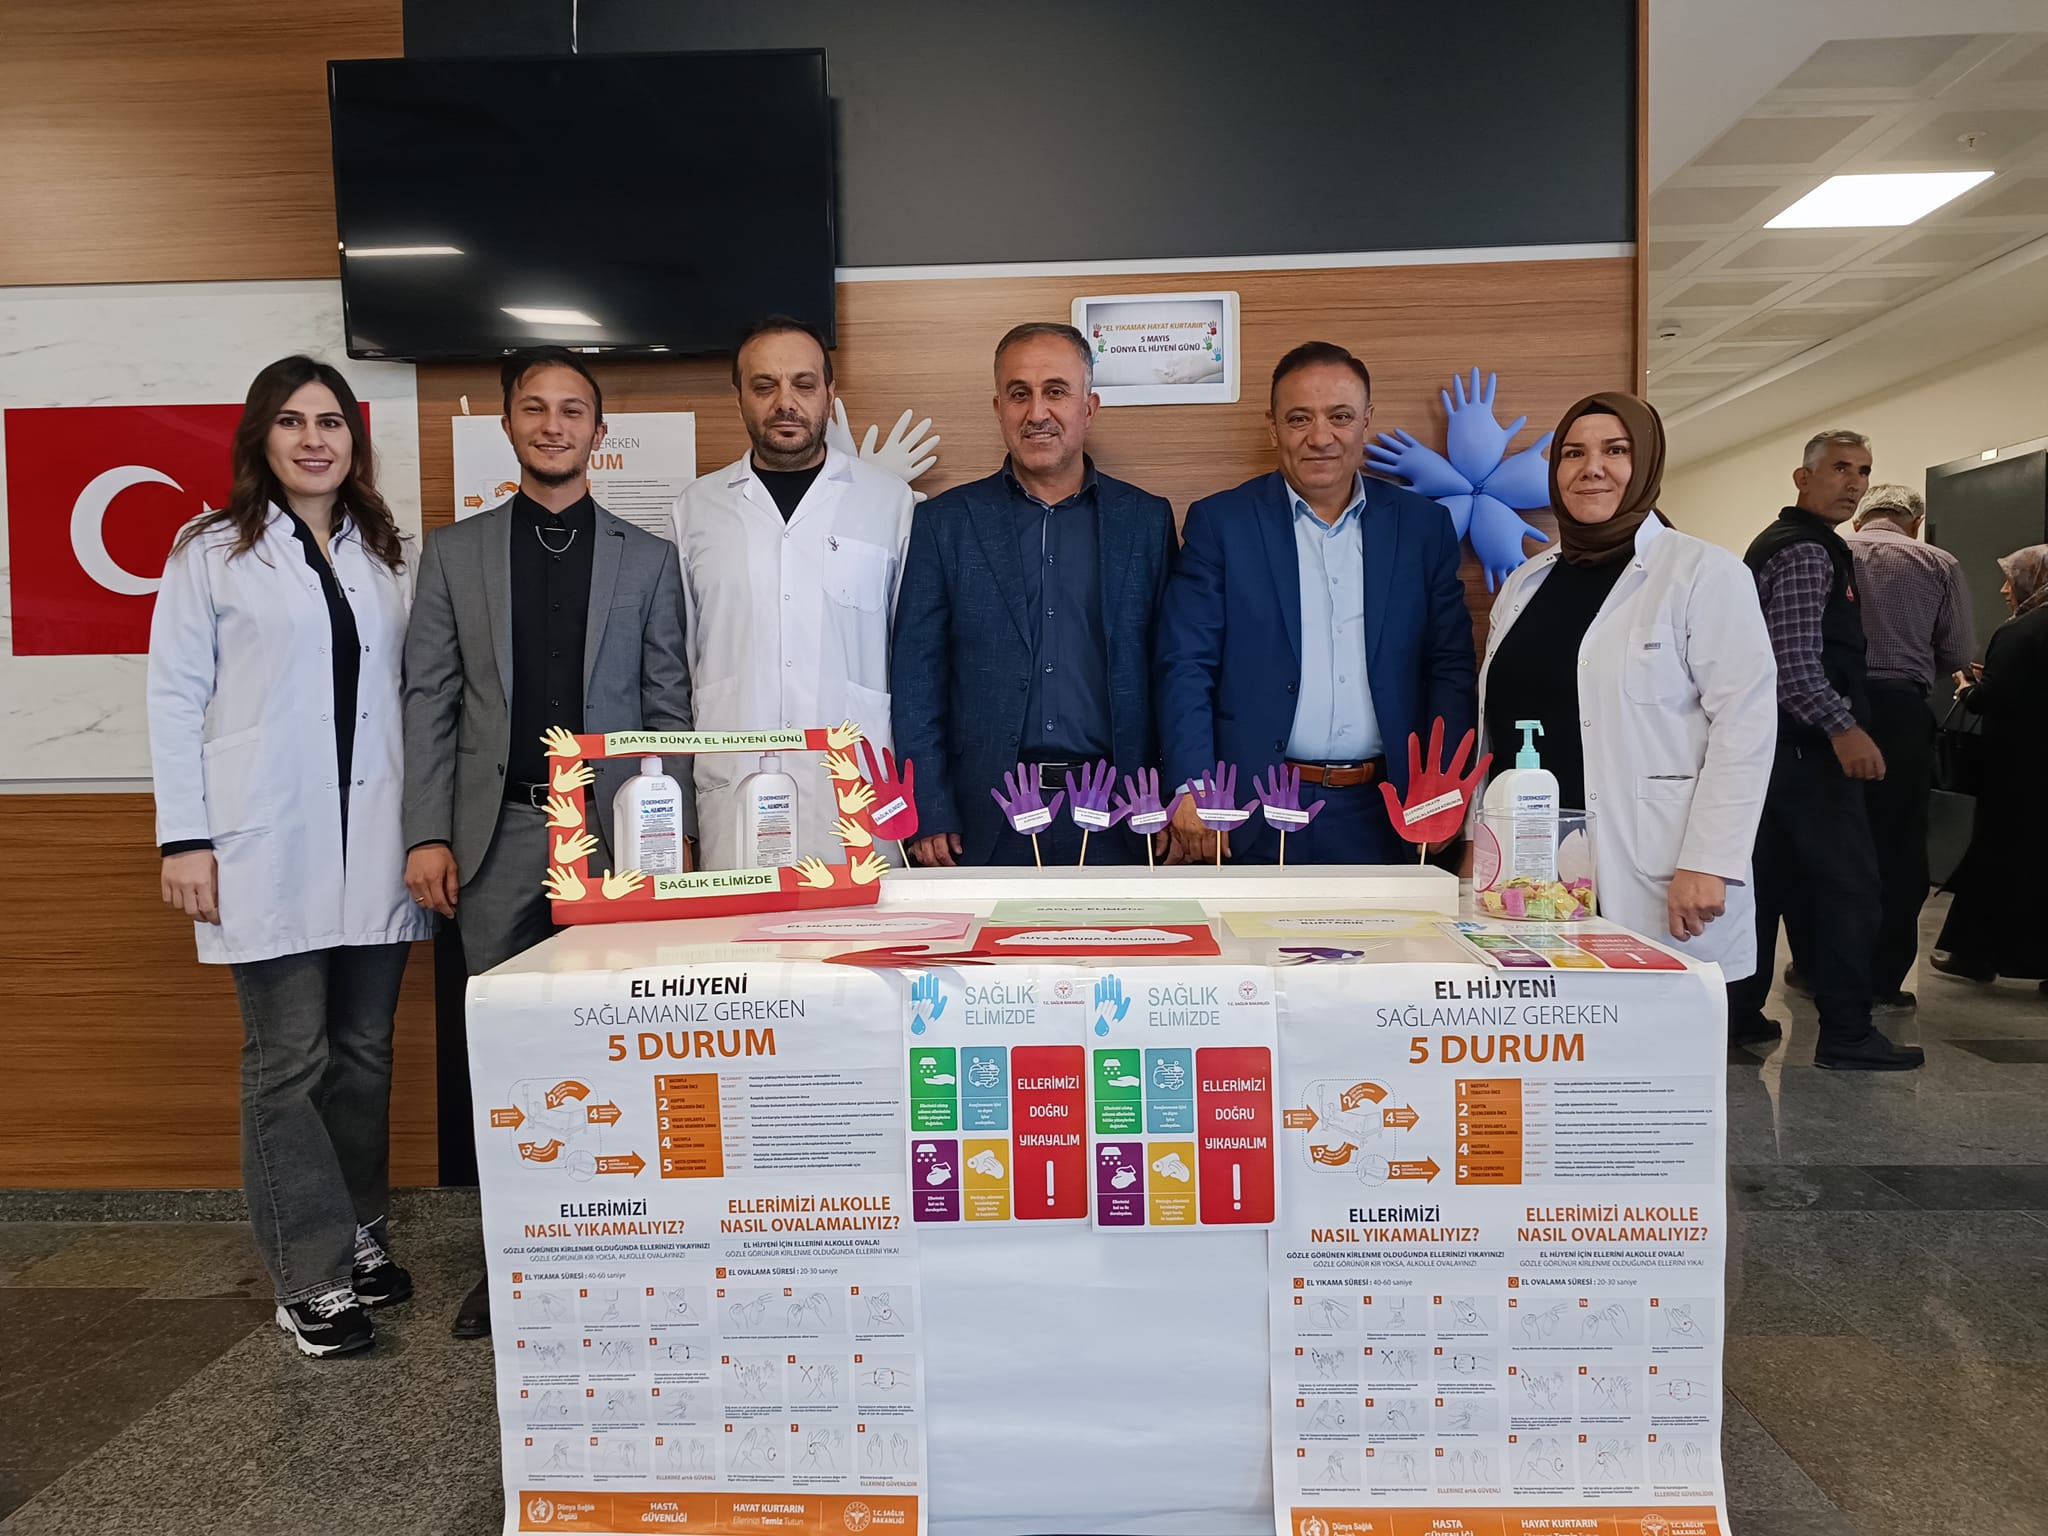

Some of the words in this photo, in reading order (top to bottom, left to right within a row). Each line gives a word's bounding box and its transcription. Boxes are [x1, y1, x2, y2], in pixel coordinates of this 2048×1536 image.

[1111, 345, 1137, 353] DÜNYA
[1178, 343, 1200, 351] GÜNÜ
[620, 736, 657, 745] MAYIS
[660, 736, 700, 745] DÜNYA
[705, 737, 719, 745] EL
[723, 734, 766, 744] HİJYENİ
[770, 734, 802, 743] GÜNÜ
[660, 878, 708, 890] SAĞLIK
[713, 875, 772, 887] ELİMİZDE
[631, 980, 655, 998] EL
[662, 973, 748, 997] HİJYENİ
[1435, 981, 1461, 1000] EL
[1468, 975, 1557, 999] HİJYENİ
[965, 981, 1035, 1005] SAĞLIK
[1148, 982, 1219, 1006] SAĞLIK
[574, 1003, 708, 1026] SAĞLAMANIZ
[714, 1000, 805, 1020] GEREKEN
[966, 1007, 1035, 1025] ELİMİZDE
[1150, 1009, 1220, 1027] ELİMİZDE
[1377, 1005, 1517, 1027] SAĞLAMANIZ
[1523, 1005, 1618, 1025] GEREKEN
[609, 1035, 627, 1061] 5
[638, 1028, 776, 1060] DURUM
[1409, 1037, 1429, 1064] 5
[1442, 1033, 1585, 1063] DURUM
[659, 1078, 665, 1091] 1
[1018, 1075, 1080, 1090] ELLERİMİZİ
[1203, 1077, 1266, 1092] ELLERİMİZİ
[1459, 1082, 1466, 1096] 1
[548, 1094, 560, 1106] 2
[659, 1098, 669, 1111] 2
[1343, 1096, 1356, 1108] 2
[589, 1109, 599, 1120] 4
[1029, 1104, 1068, 1117] DOĞRU
[1216, 1106, 1255, 1120] DOĞRU
[1458, 1103, 1469, 1117] 2
[492, 1113, 499, 1124] 1
[660, 1117, 670, 1130] 3
[1285, 1114, 1292, 1125] 1
[1385, 1112, 1395, 1123] 4
[1458, 1123, 1469, 1136] 3
[661, 1137, 672, 1150] 4
[1019, 1134, 1080, 1147] YIKAYALIM
[1205, 1137, 1267, 1150] YIKAYALIM
[522, 1145, 533, 1156] 3
[1313, 1147, 1325, 1159] 3
[1458, 1143, 1469, 1156] 4
[599, 1160, 608, 1171] 5
[664, 1159, 672, 1172] 5
[1391, 1165, 1401, 1176] 5
[1458, 1165, 1469, 1178] 5
[1047, 1161, 1055, 1206] !
[1233, 1164, 1241, 1210] !
[561, 1199, 647, 1218] ELLERİMİZİ
[728, 1195, 815, 1213] ELLERİMİZİ
[820, 1196, 891, 1212] ALKOLLE
[1350, 1205, 1440, 1223] ELLERİMİZİ
[1526, 1204, 1618, 1222] ELLERİMİZİ
[1623, 1207, 1699, 1222] ALKOLLE
[525, 1224, 571, 1238] NASIL
[575, 1220, 685, 1237] YIKAMALIYIZ?
[721, 1219, 767, 1233] NASIL
[771, 1216, 900, 1232] OVALAMALIYIZ?
[1311, 1229, 1360, 1243] NASIL
[1363, 1228, 1479, 1242] YIKAMALIYIZ?
[1518, 1228, 1567, 1242] NASIL
[1572, 1227, 1708, 1241] OVALAMALIYIZ?
[527, 1246, 559, 1254] GÖRÜNEN
[561, 1245, 594, 1253] KİRLENME
[595, 1244, 638, 1252] OLDUĞUNDA
[779, 1240, 793, 1249] İÇİN
[1311, 1251, 1345, 1259] GÖRÜNEN
[1578, 1251, 1592, 1259] İÇİN
[819, 1268, 838, 1276] saniye
[557, 1503, 575, 1511] Dünya
[733, 1503, 760, 1512] HAYAT
[762, 1504, 804, 1513] KURTARIN
[557, 1512, 578, 1520] Örgütü
[642, 1512, 687, 1523] GÜVENLİĞİ
[762, 1517, 783, 1525] Temiz
[785, 1517, 804, 1525] Tutun
[873, 1516, 904, 1524] BAKANLIĞI
[1433, 1520, 1463, 1528] HASTA
[1521, 1520, 1550, 1528] HAYAT
[1552, 1519, 1598, 1528] KURTARIN
